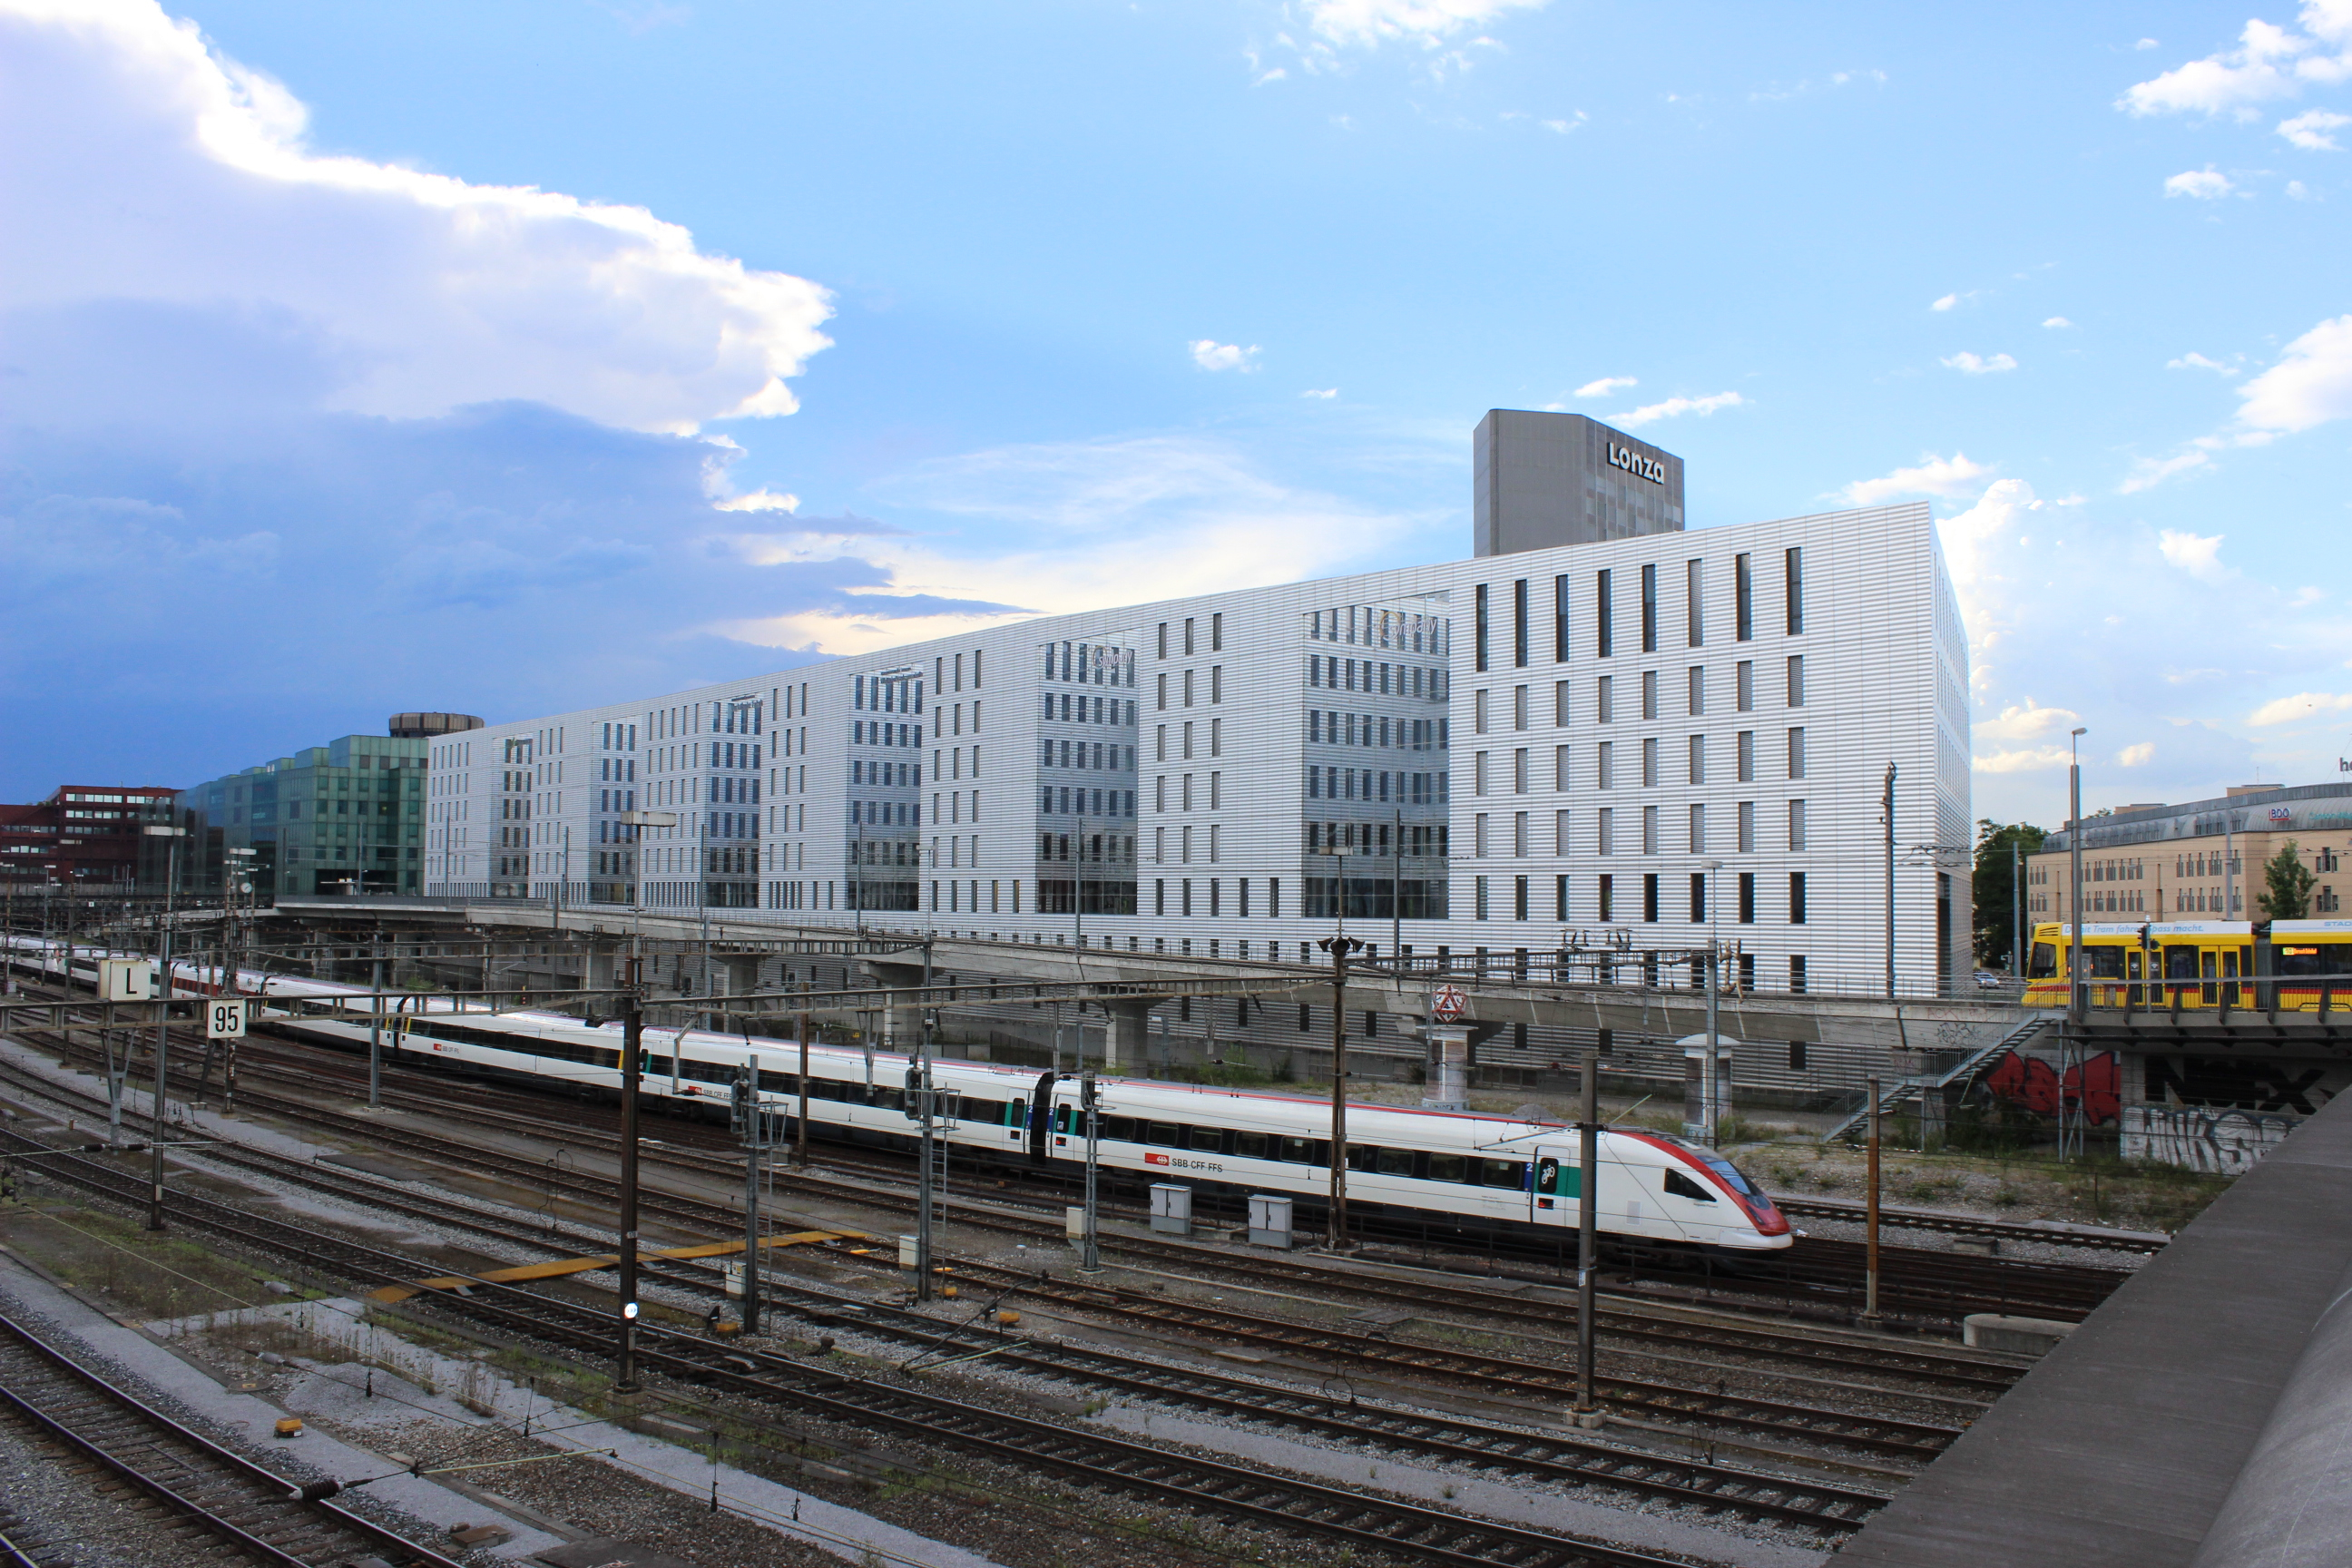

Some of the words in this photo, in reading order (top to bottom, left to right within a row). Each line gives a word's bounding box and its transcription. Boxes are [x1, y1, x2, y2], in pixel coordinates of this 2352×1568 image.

[1607, 442, 1665, 485] Lonza
[2270, 808, 2290, 818] BDO
[2093, 925, 2114, 933] Tram
[2116, 924, 2140, 934] fahre
[2172, 923, 2204, 933] macht.
[126, 967, 137, 995] L
[215, 1005, 239, 1033] 95
[1028, 1105, 1034, 1113] 2
[1048, 1108, 1054, 1116] 2
[1171, 1158, 1189, 1169] SBB
[1191, 1161, 1206, 1171] CFF
[1208, 1162, 1223, 1173] FFS
[1526, 1162, 1534, 1172] 2
